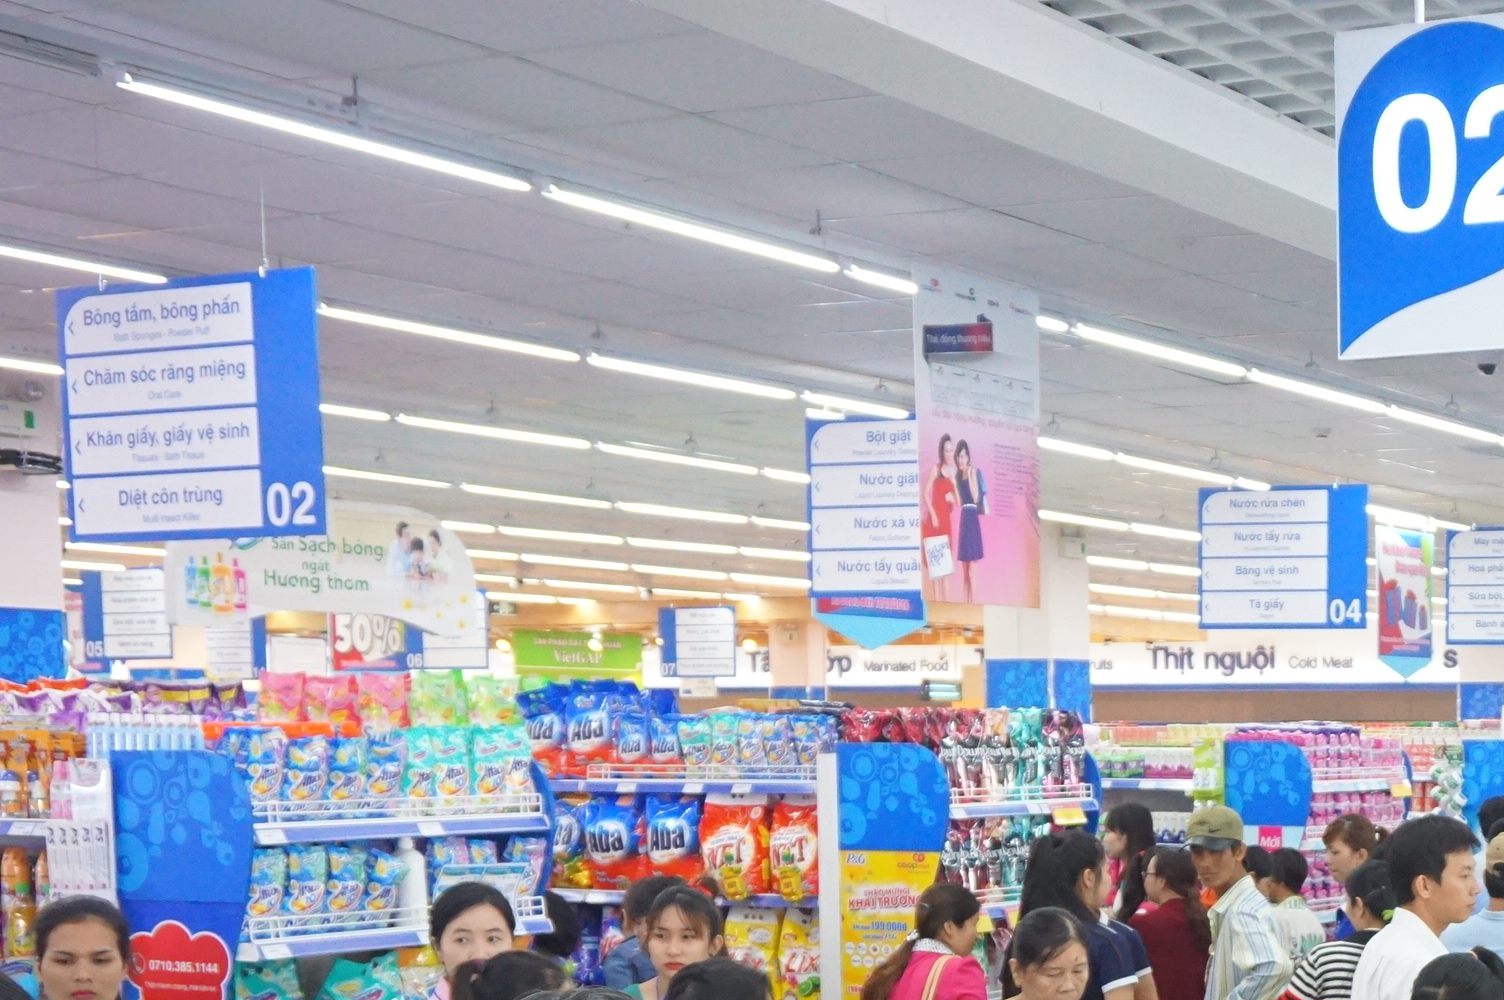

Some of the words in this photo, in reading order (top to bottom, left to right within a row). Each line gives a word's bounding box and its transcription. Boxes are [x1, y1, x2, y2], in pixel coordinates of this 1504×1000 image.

[83, 308, 121, 328] Bông
[125, 303, 156, 325] tắm,
[161, 301, 198, 322] bông
[202, 294, 239, 319] phấn
[84, 367, 126, 387] Chăm
[130, 365, 156, 383] sóc
[161, 364, 194, 384] răng
[199, 359, 246, 382] miệng
[87, 429, 122, 447] Khăn
[128, 424, 159, 449] giấy,
[163, 423, 193, 446] giấy
[199, 425, 214, 447] vệ
[219, 422, 249, 439] sinh
[866, 430, 887, 446] Bột
[889, 429, 911, 447] giặt
[859, 473, 893, 485] Nước
[118, 486, 147, 507] Diệt
[151, 486, 178, 504] côn
[183, 484, 223, 506] trùng
[266, 481, 317, 527] 02
[1229, 498, 1258, 508] Nước
[1281, 497, 1305, 507] chén
[854, 516, 888, 530] Nước
[891, 513, 905, 528] xả
[1234, 531, 1262, 542] Nước
[1265, 529, 1280, 543] tẩy
[298, 535, 336, 557] Sạch
[343, 537, 384, 562] bóng
[302, 558, 330, 573] ngát
[838, 560, 872, 572] Nước
[874, 557, 891, 575] tẩy
[1235, 566, 1260, 577] Băng
[1263, 565, 1276, 576] vệ
[1278, 565, 1299, 575] sinh
[264, 570, 321, 594] Hương
[327, 571, 370, 591] thơm
[1264, 597, 1284, 610] giấy
[1329, 598, 1361, 622] 04
[335, 614, 401, 654] 50%
[86, 641, 103, 657] 05
[554, 650, 602, 664] VietGAP
[406, 653, 422, 668] 06
[662, 663, 675, 675] 07
[864, 658, 915, 672] Marinated
[920, 658, 949, 672] Food
[1090, 659, 1113, 670] ruits
[1151, 646, 1194, 675] Thịt
[1204, 645, 1275, 676] nguội
[1288, 656, 1318, 669] Cold
[1323, 656, 1354, 669] Meat
[588, 823, 624, 853] Aba
[650, 822, 685, 852] Aba
[1260, 832, 1282, 849] Mới
[846, 852, 865, 865] P&G
[848, 897, 876, 912] KHAI
[148, 959, 219, 974] 0710.385.1144
